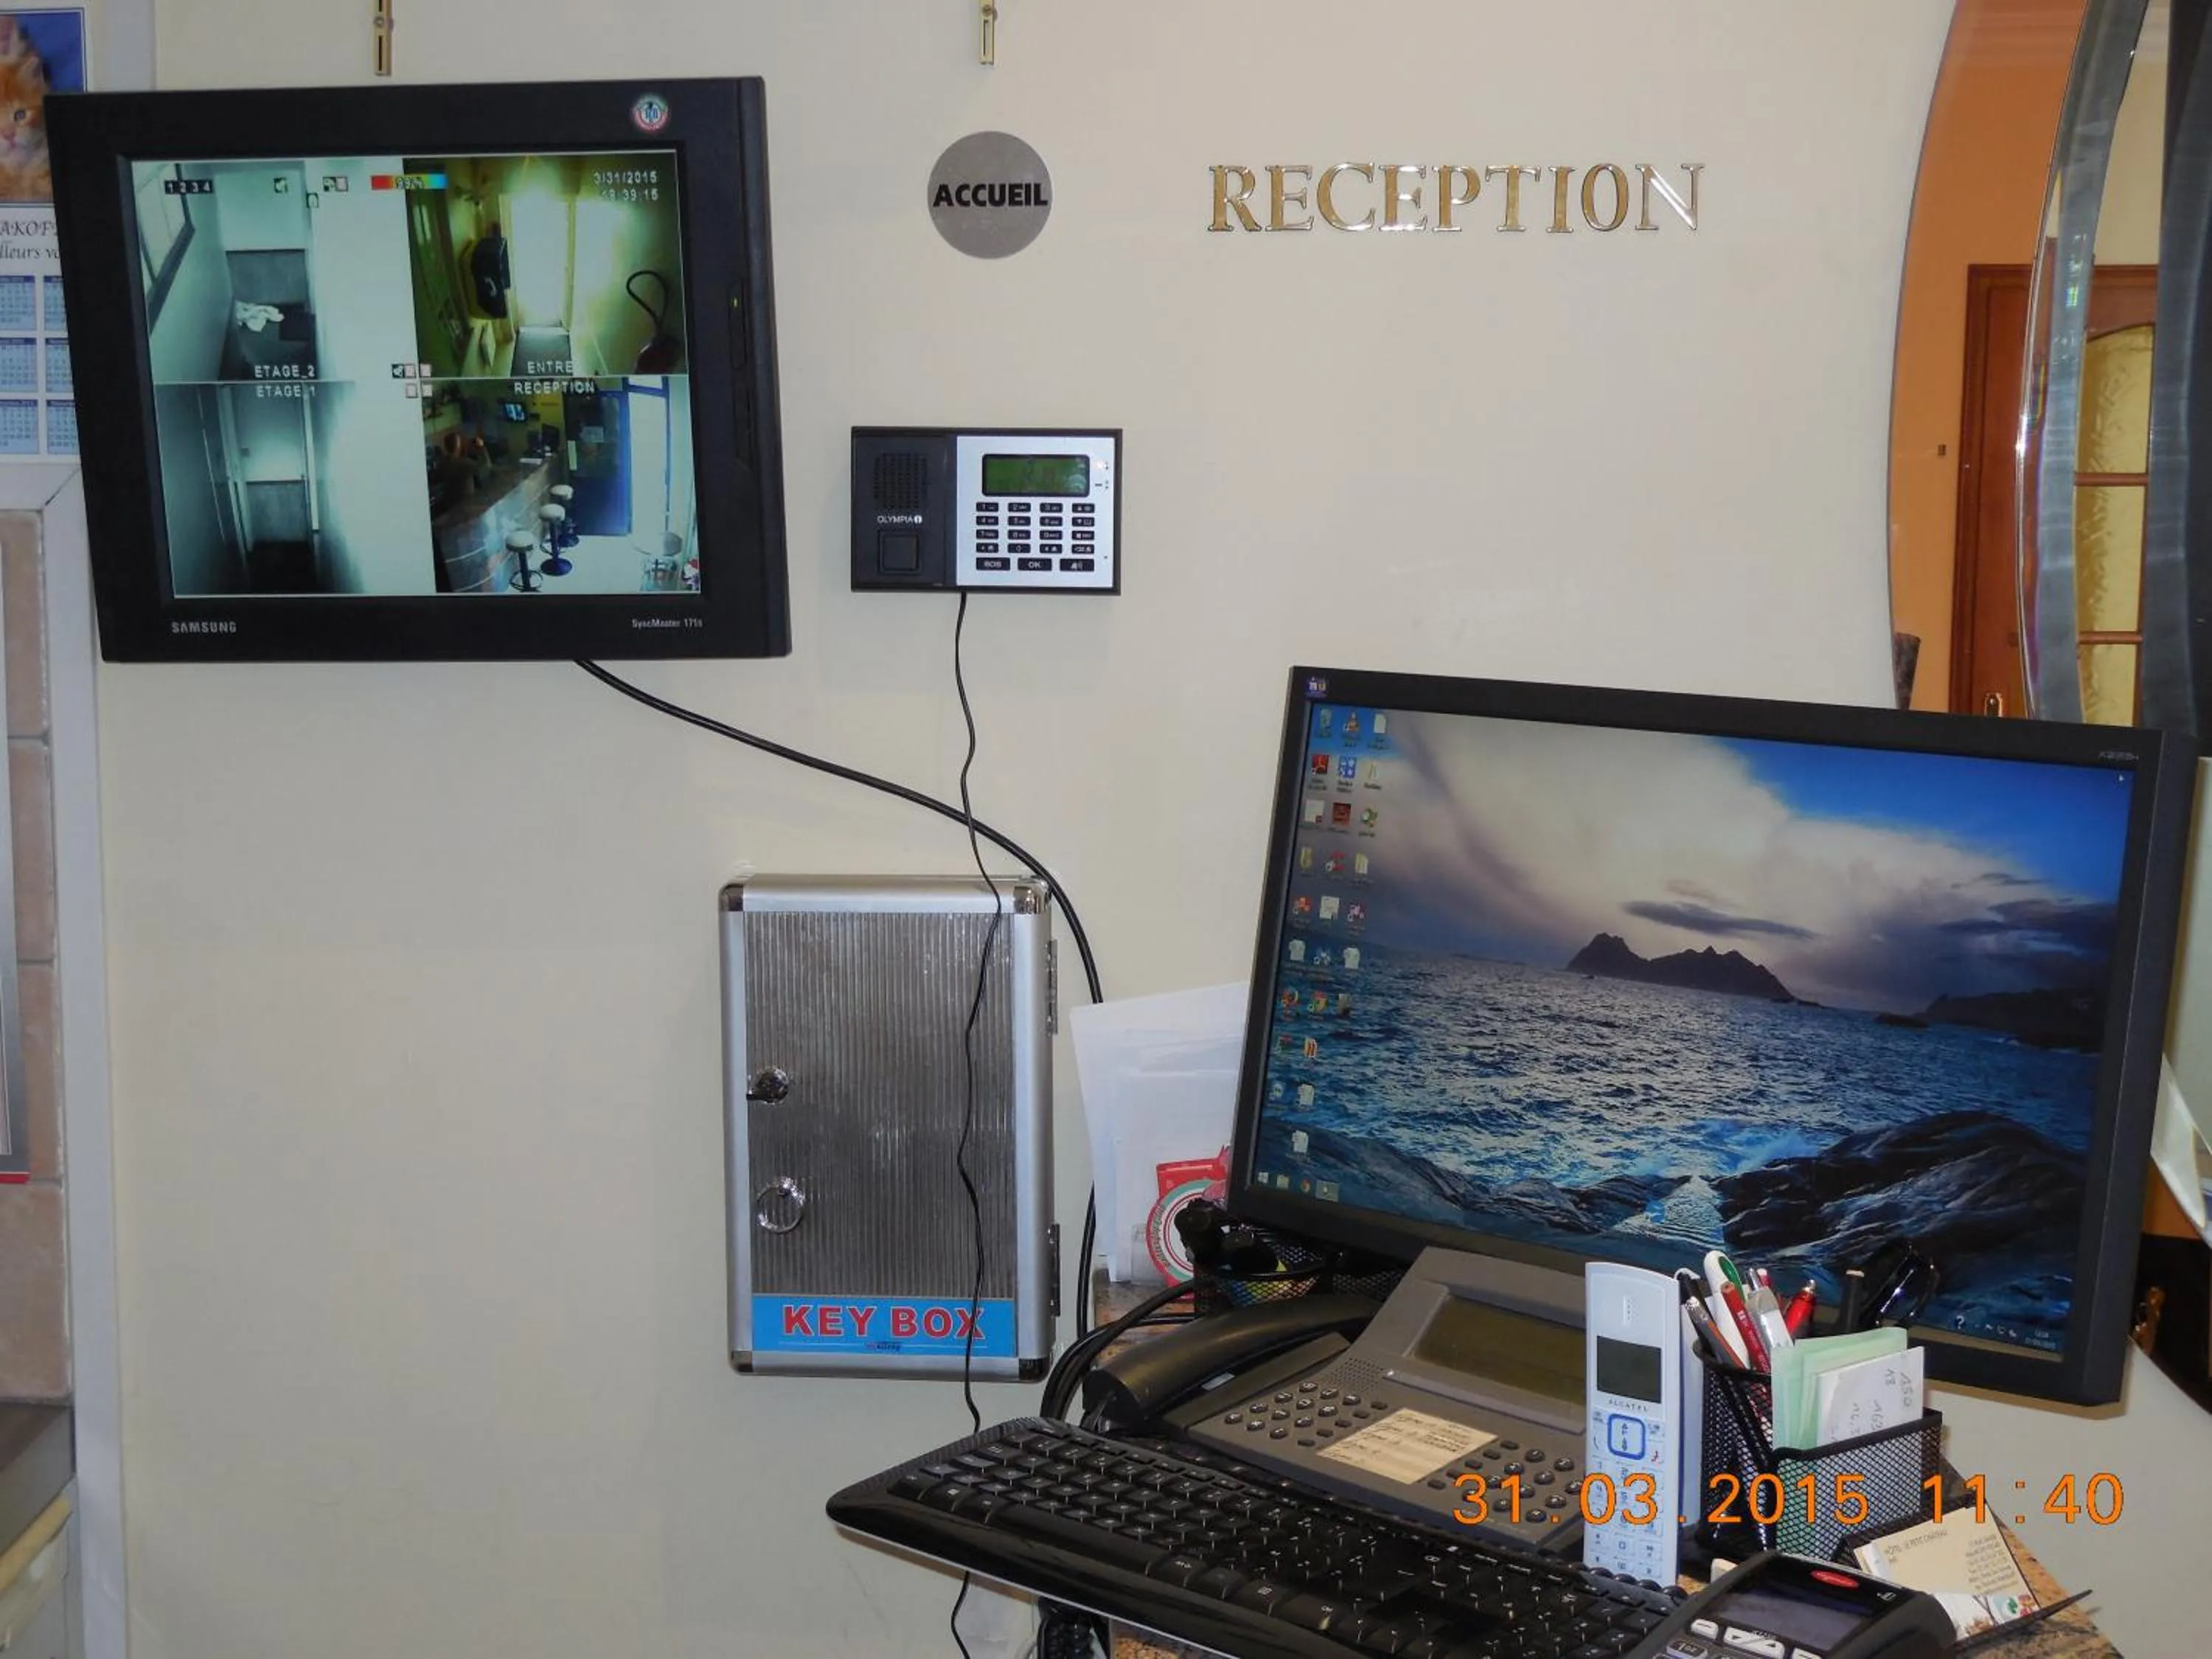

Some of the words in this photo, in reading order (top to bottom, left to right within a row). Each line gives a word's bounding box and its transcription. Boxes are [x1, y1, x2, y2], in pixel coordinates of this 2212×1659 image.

[933, 183, 1048, 207] ACCUEIL
[1207, 161, 1705, 234] RECEPTION
[514, 380, 596, 395] RECEPTION
[877, 515, 914, 524] OLYMPIA
[171, 620, 237, 634] SAMSUNG
[782, 1304, 878, 1338] KEY
[889, 1305, 986, 1340] BOX
[1607, 1397, 1647, 1412] ALCATEL
